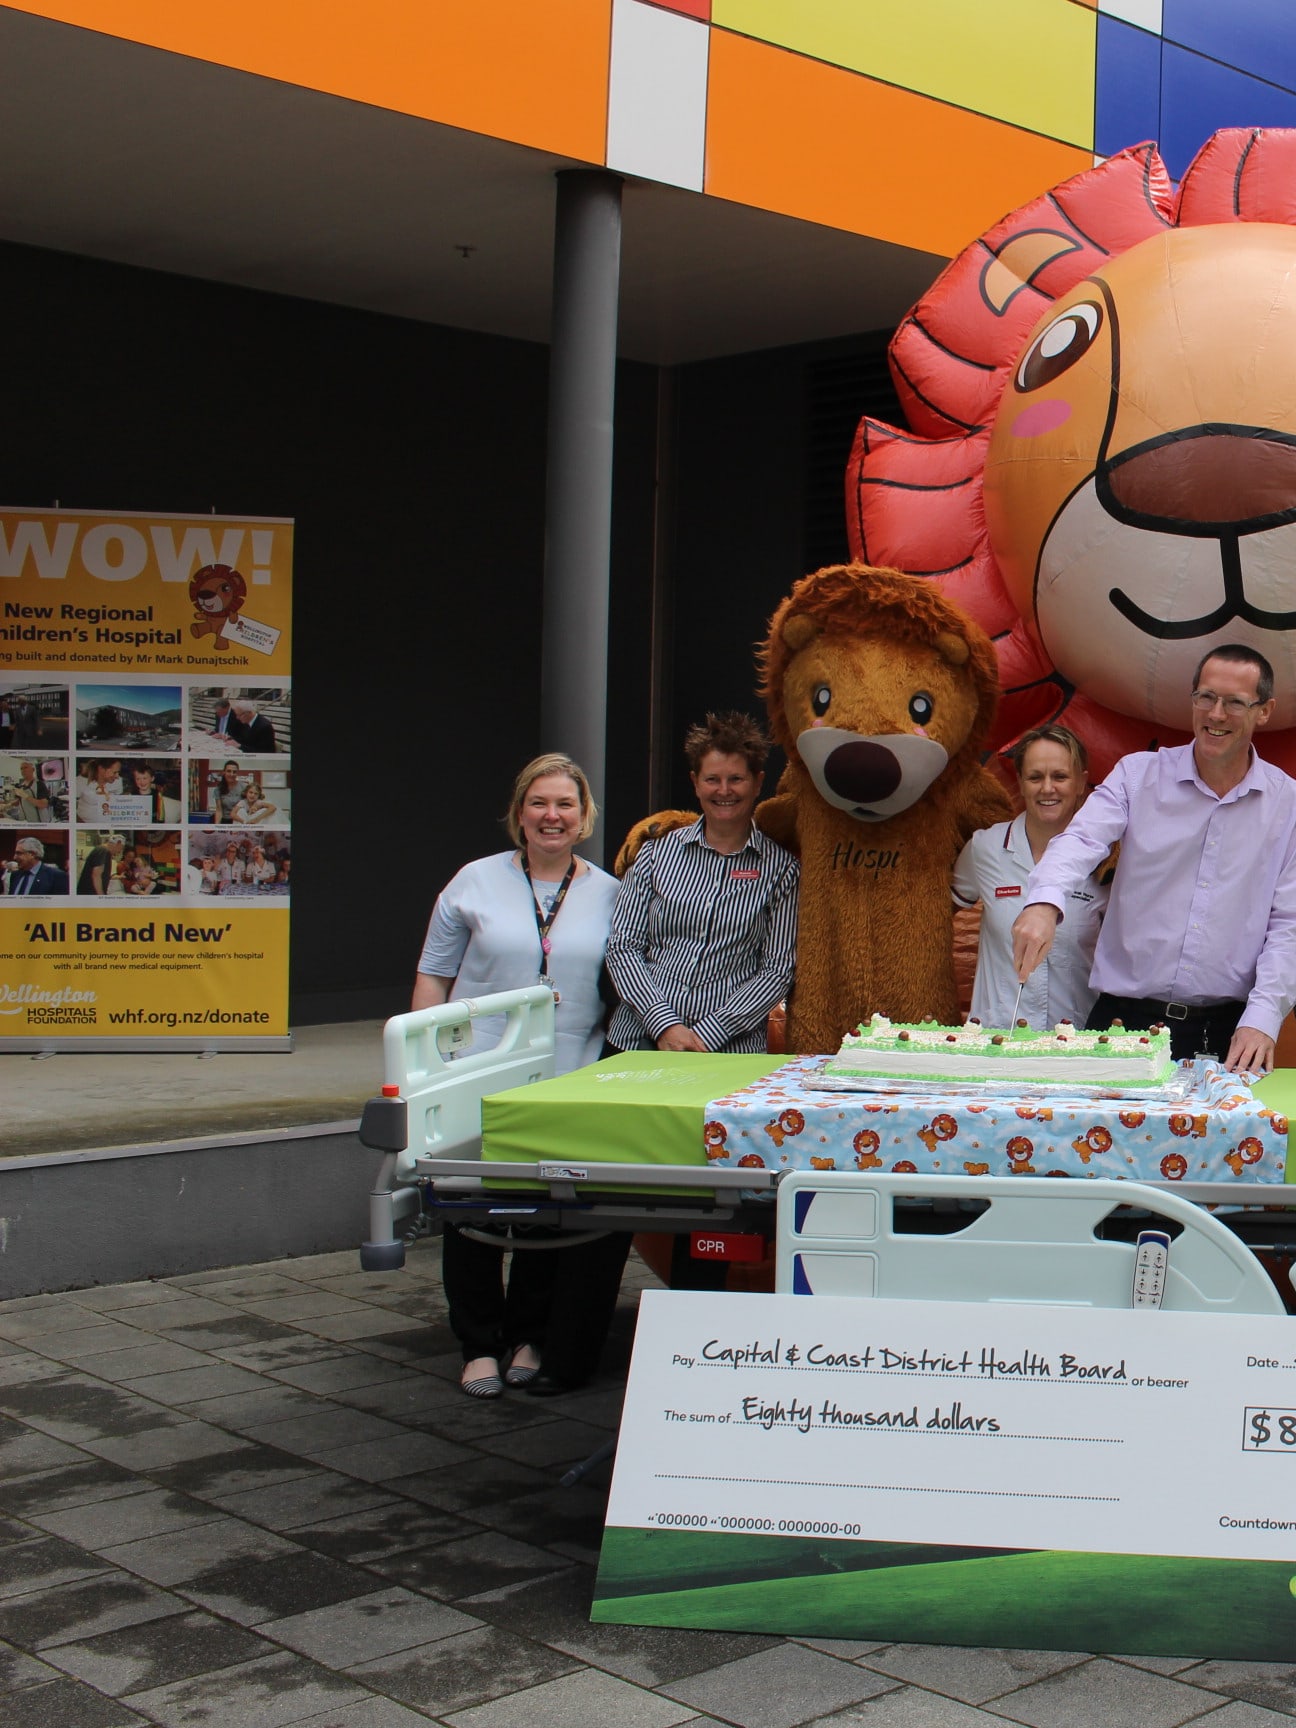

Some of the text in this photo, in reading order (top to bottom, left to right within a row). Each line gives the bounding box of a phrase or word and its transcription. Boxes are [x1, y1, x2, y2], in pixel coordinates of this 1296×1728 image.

[0, 520, 274, 585] WOW!
[4, 602, 153, 624] New Regional
[96, 628, 182, 647] Hospital
[16, 651, 42, 660] built
[45, 652, 67, 661] and
[70, 652, 117, 663] donated
[120, 653, 133, 665] by
[136, 654, 152, 663] Mr
[155, 654, 183, 664] Mark
[187, 655, 249, 667] Dunajtschik
[828, 841, 904, 879] Hospi
[24, 922, 232, 942] ‘All Brand New’
[44, 952, 87, 961] community
[89, 952, 118, 961] journey
[121, 952, 130, 960] to
[131, 952, 160, 961] provide
[233, 952, 264, 961] hospital
[160, 963, 203, 972] equipment.
[27, 1008, 96, 1017] HOSPITALS
[109, 1009, 270, 1027] whf.org.nz/donate
[697, 1239, 725, 1253] CPR
[672, 1338, 1189, 1389] Pay Capital & Coast District Health Board or bearer
[1247, 1356, 1279, 1369] Date
[664, 1397, 1000, 1433] The sum of Eighty thousand dollars
[778, 1519, 861, 1536] 0000000-00
